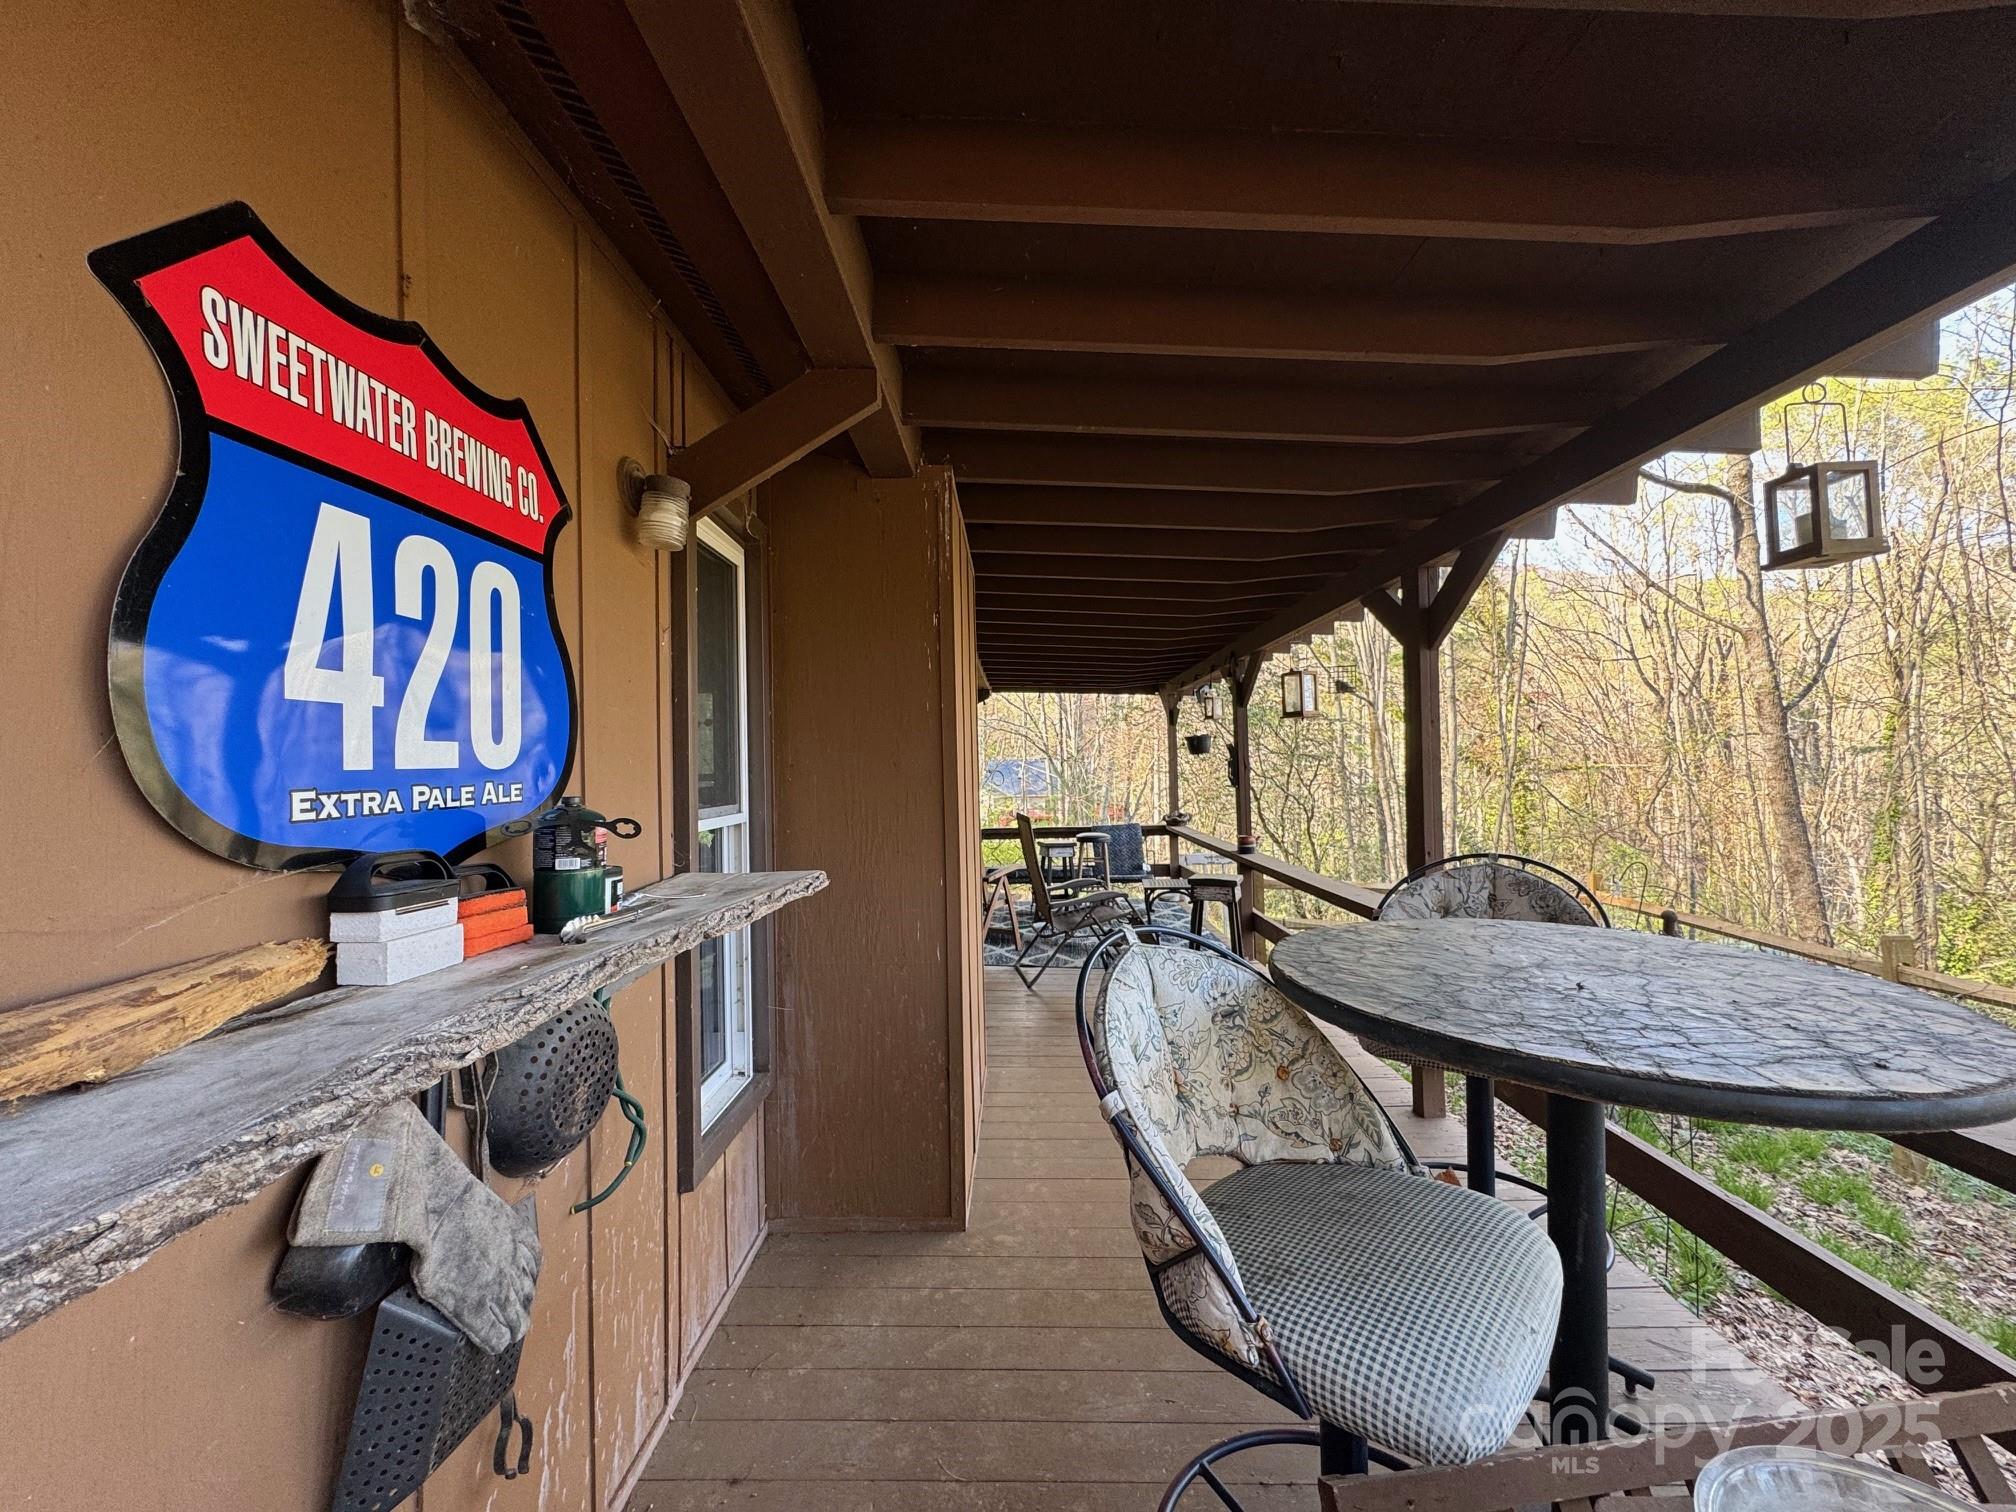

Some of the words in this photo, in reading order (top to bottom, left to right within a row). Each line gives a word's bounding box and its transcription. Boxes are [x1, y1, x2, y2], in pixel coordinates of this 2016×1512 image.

[201, 286, 418, 461] SWEETWATER
[425, 410, 513, 509] BREWING
[517, 465, 544, 523] CO.
[284, 501, 523, 771] 420
[290, 789, 404, 822] EXTRA
[480, 781, 523, 805] ALE
